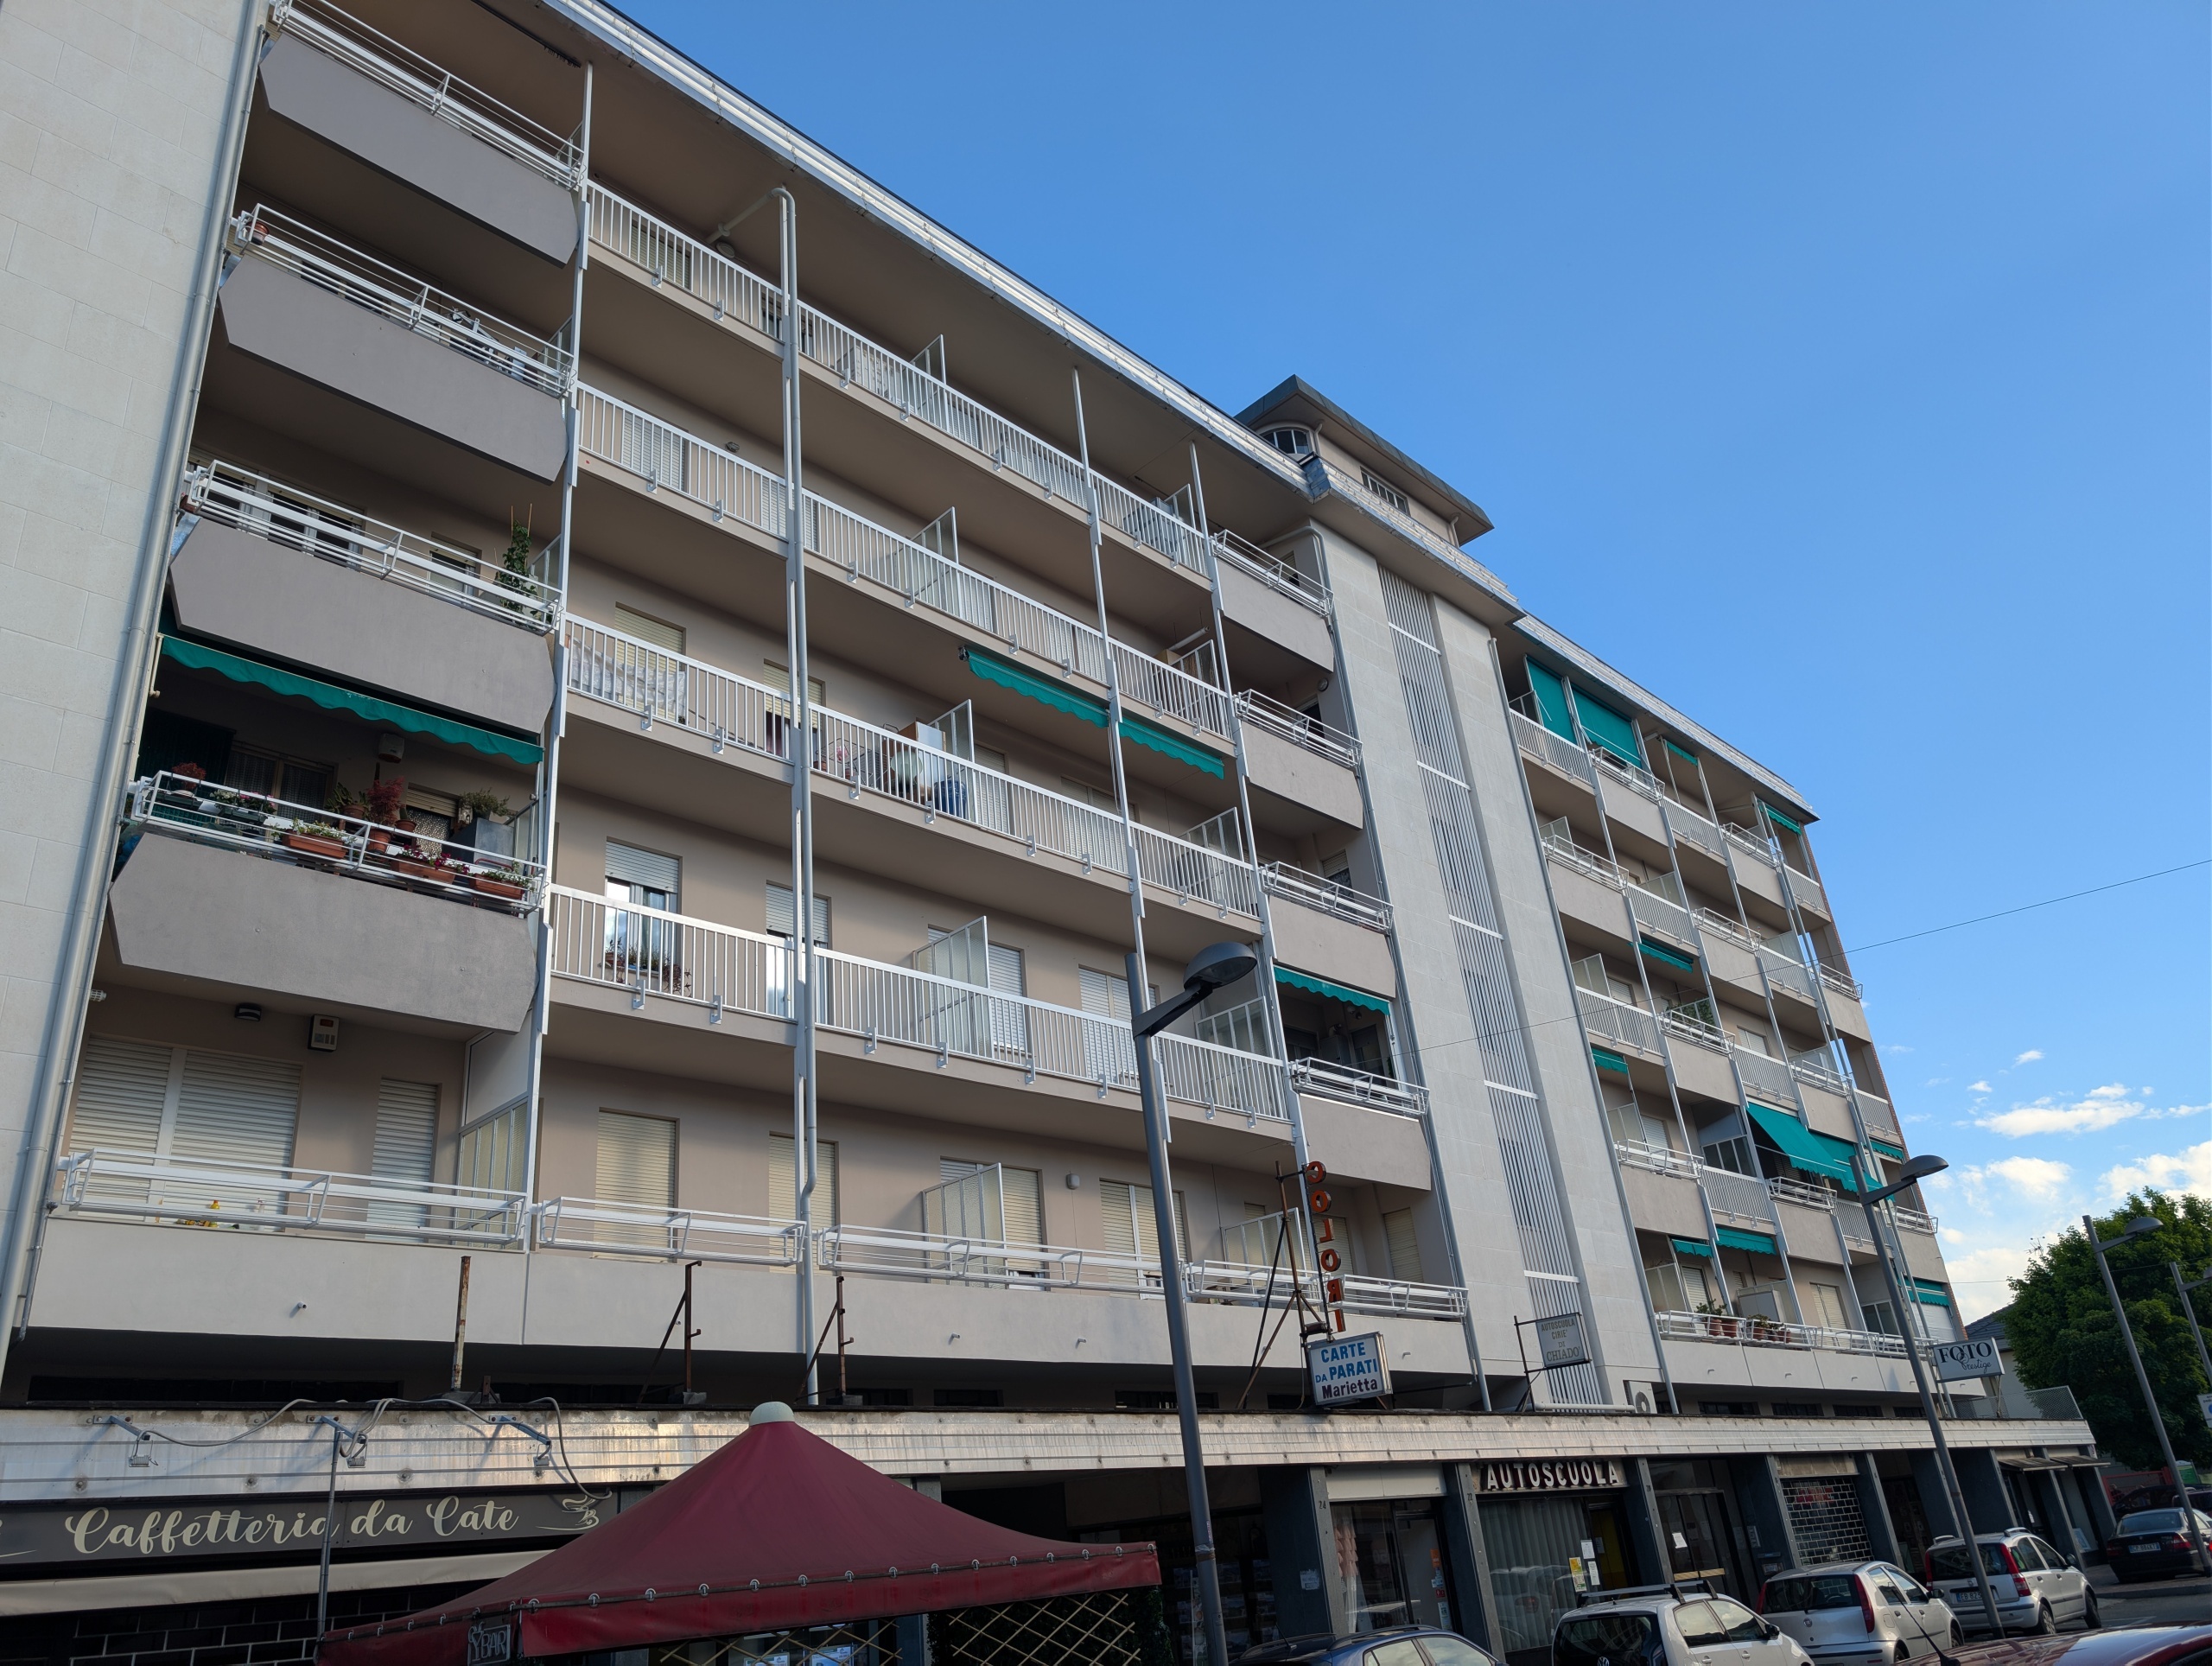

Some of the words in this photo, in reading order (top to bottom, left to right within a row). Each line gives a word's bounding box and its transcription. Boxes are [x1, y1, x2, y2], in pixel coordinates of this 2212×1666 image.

[1541, 1318, 1576, 1332] AUTOSCUOLA
[1320, 1342, 1366, 1363] CARTE
[1937, 1342, 1993, 1364] FOTO
[1956, 1352, 1992, 1374] Prestige
[1315, 1374, 1328, 1383] DA
[1328, 1358, 1378, 1381] PARATI
[1321, 1378, 1378, 1399] Marietta
[1487, 1460, 1620, 1490] AUTOSCUOLA
[1318, 1500, 1327, 1510] 24
[65, 1507, 340, 1555] Caffetteria
[351, 1498, 414, 1537] da
[426, 1496, 519, 1536] Cate
[481, 1630, 506, 1658] BAR
